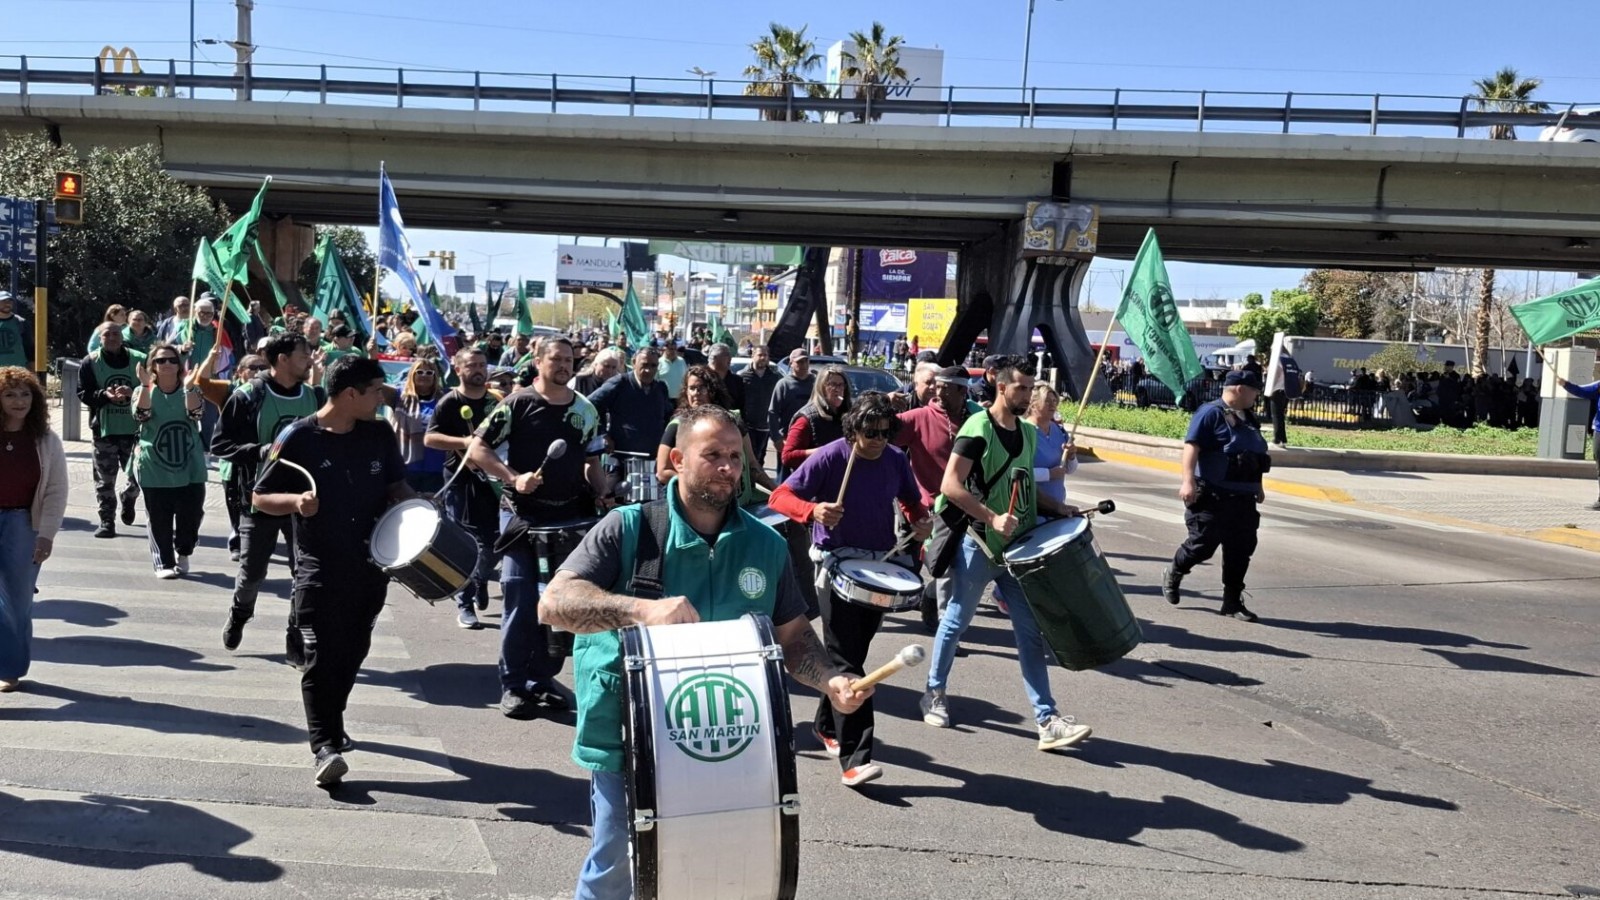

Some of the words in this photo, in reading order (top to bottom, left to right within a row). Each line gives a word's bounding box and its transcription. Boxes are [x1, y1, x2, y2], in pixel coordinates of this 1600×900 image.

[576, 259, 622, 269] MANDUCA
[882, 274, 912, 282] SIEMPRE
[669, 730, 699, 741] SAN
[704, 725, 760, 739] MARTIN
